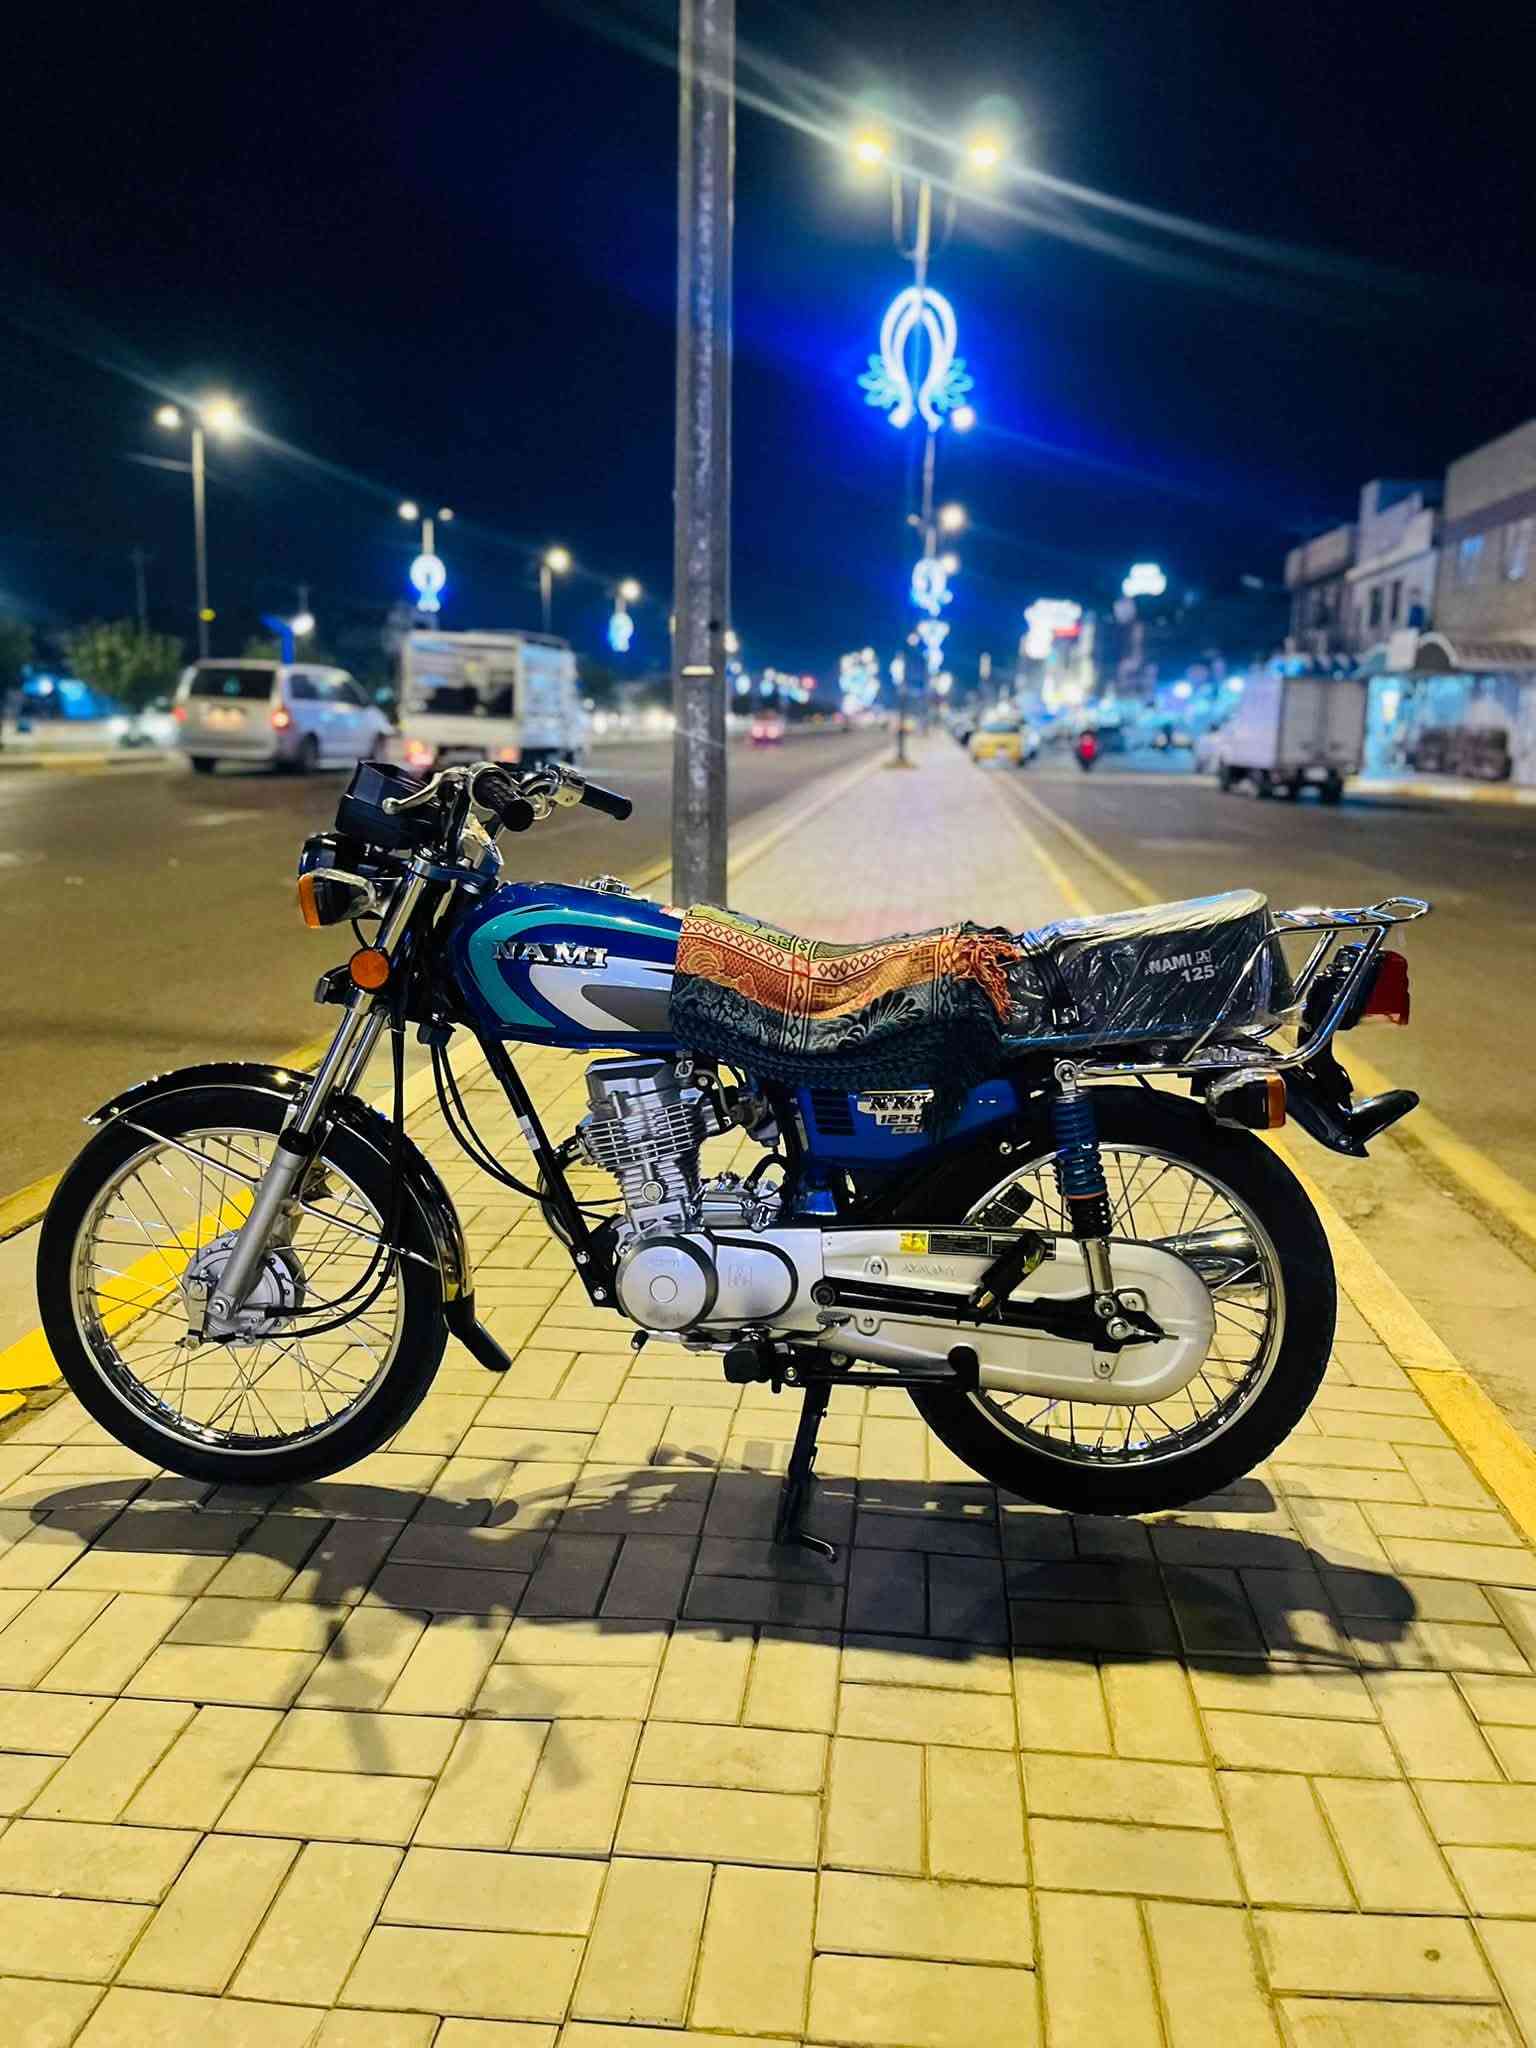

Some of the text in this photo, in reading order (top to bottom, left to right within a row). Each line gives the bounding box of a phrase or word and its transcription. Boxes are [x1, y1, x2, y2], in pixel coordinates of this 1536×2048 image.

[491, 942, 608, 968] NAMI
[1148, 953, 1193, 976] NAMI
[1180, 964, 1216, 983] 125
